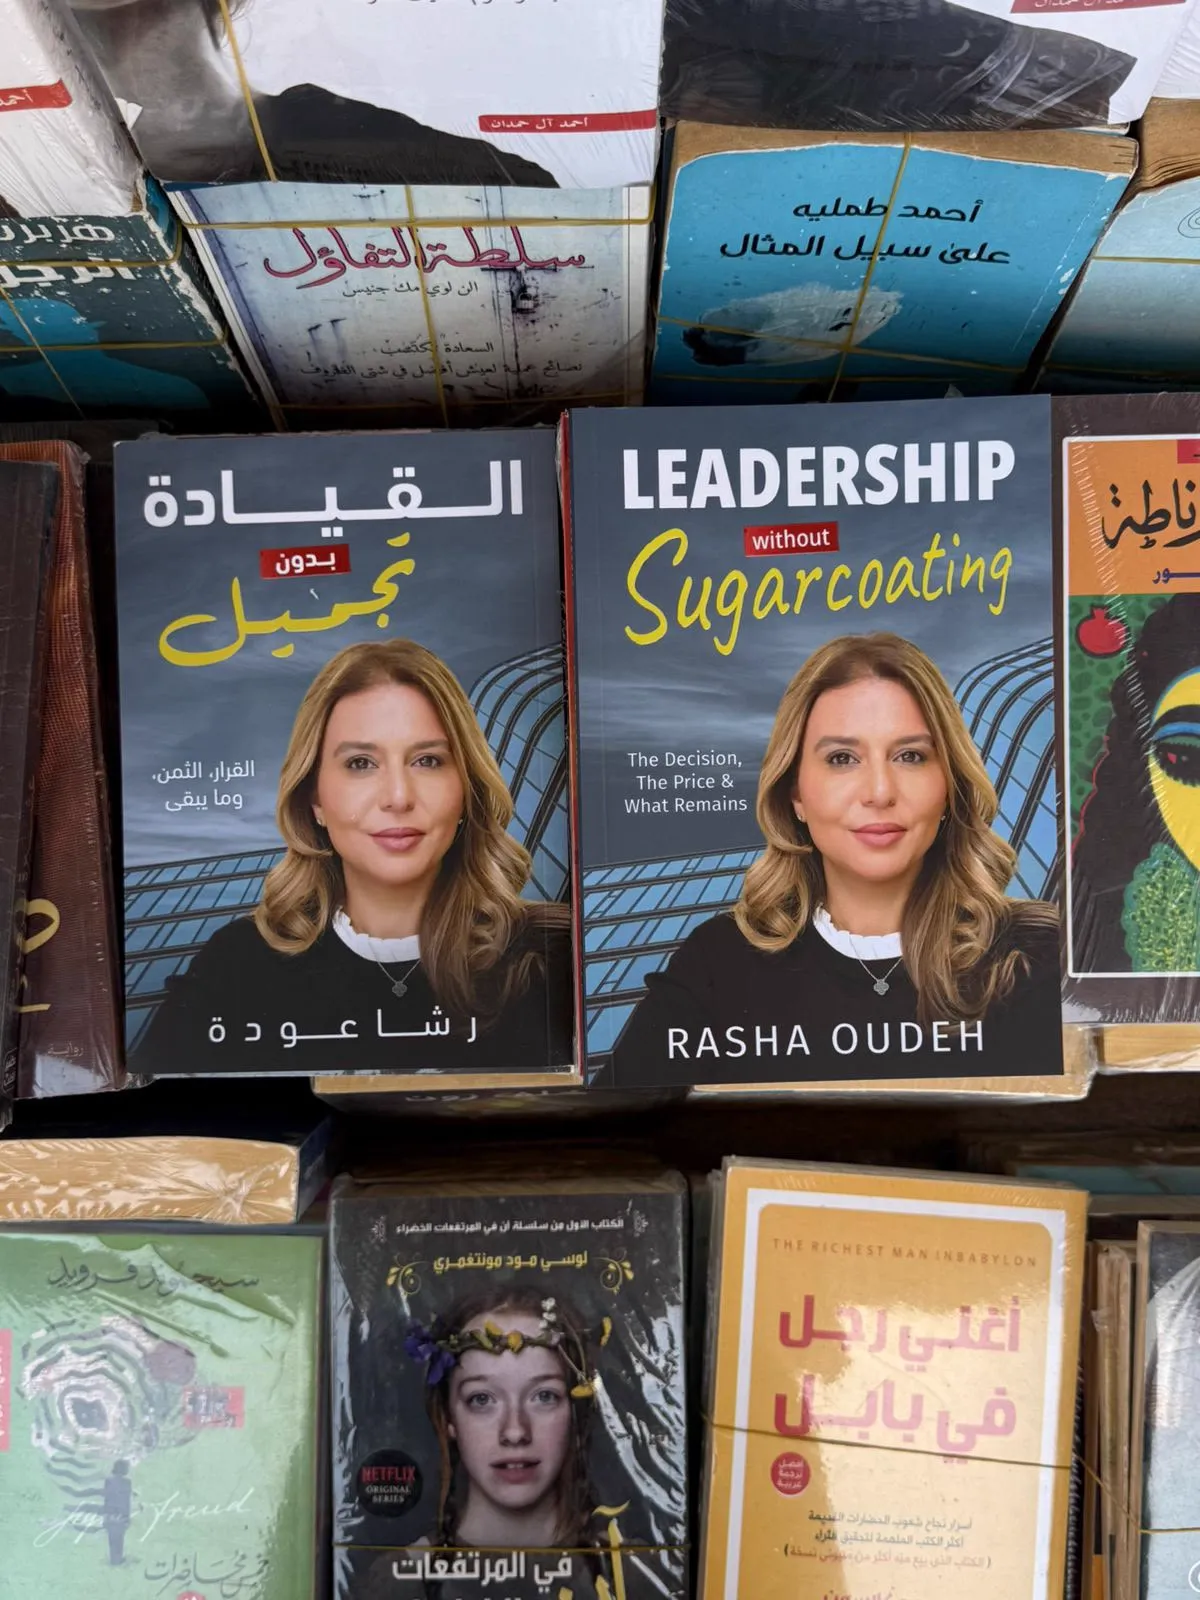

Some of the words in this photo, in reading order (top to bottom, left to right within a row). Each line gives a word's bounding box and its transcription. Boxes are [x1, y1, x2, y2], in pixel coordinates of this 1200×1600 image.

[898, 199, 985, 223] أحمد
[719, 233, 826, 259] المثال
[833, 234, 931, 261] سبيل
[622, 439, 1016, 510] LEADERSHIP
[143, 459, 524, 538] القيادة
[751, 528, 830, 551] without
[275, 549, 336, 575] بدون
[158, 532, 416, 667] تجميل
[624, 527, 1013, 657] Sugarcoating
[627, 751, 659, 767] The
[665, 749, 742, 768] Decision,
[636, 774, 668, 790] The
[674, 772, 715, 789] Price
[721, 773, 734, 788] &
[164, 791, 209, 811] يبقى
[214, 788, 243, 809] وما
[624, 798, 669, 814] What
[675, 795, 748, 813] Remains
[208, 1016, 359, 1048] عودة
[376, 1005, 478, 1043] رشا
[667, 1023, 811, 1060] RASHA
[831, 1020, 984, 1055] OUDEH
[540, 1250, 588, 1272] لوسي
[773, 1238, 804, 1251] THE
[811, 1240, 885, 1257] RICHEST
[891, 1246, 929, 1260] MAN
[433, 1252, 503, 1275] مونتغمري
[506, 1253, 538, 1271] مود
[779, 1294, 888, 1353] رجل
[774, 1374, 925, 1443] بابل
[361, 1466, 416, 1483] NETFLIX
[365, 1485, 411, 1495] ORIGINAL
[372, 1495, 405, 1503] SERIES
[391, 1551, 526, 1586] المرتفعات
[533, 1552, 573, 1593] في
